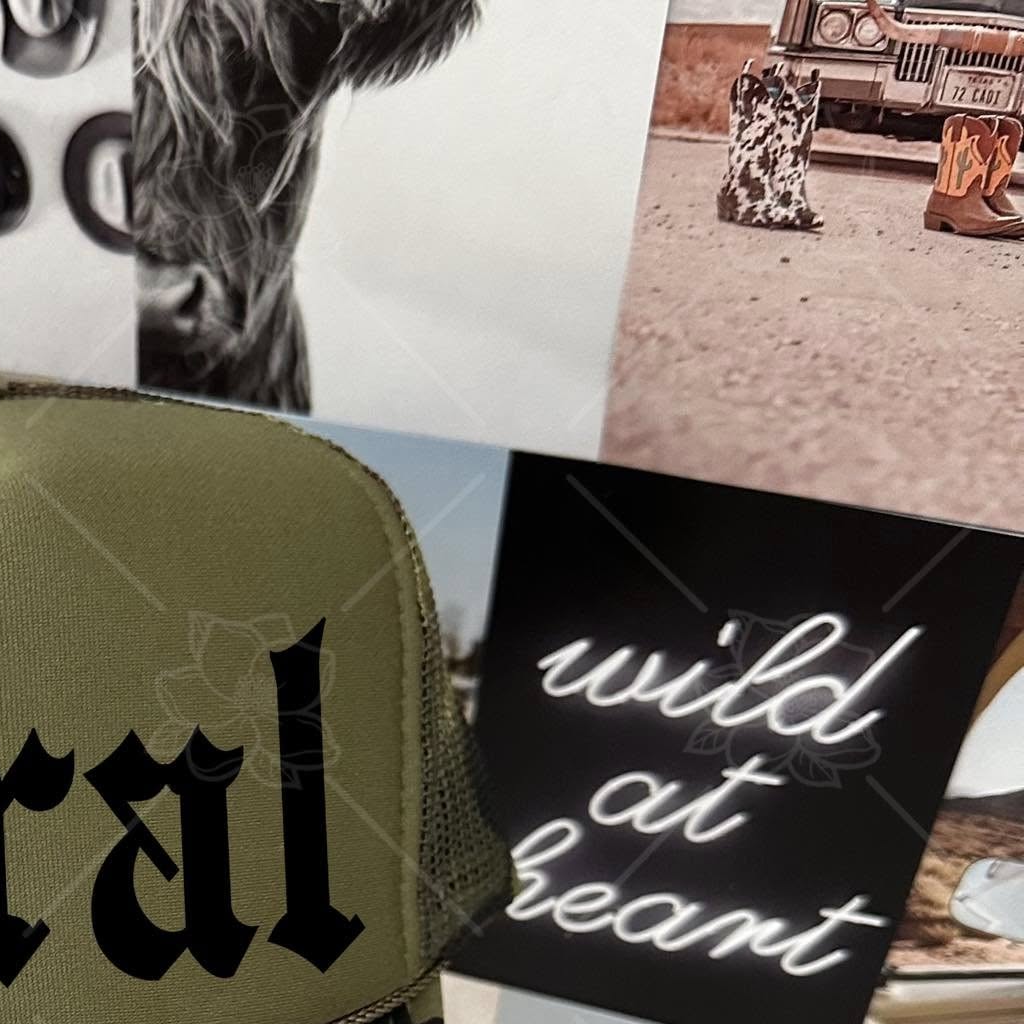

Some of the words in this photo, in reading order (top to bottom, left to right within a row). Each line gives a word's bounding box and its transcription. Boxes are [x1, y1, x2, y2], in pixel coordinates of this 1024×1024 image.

[952, 86, 967, 102] 72
[537, 612, 926, 745] wild
[588, 755, 787, 844] at
[505, 818, 890, 977] heart
